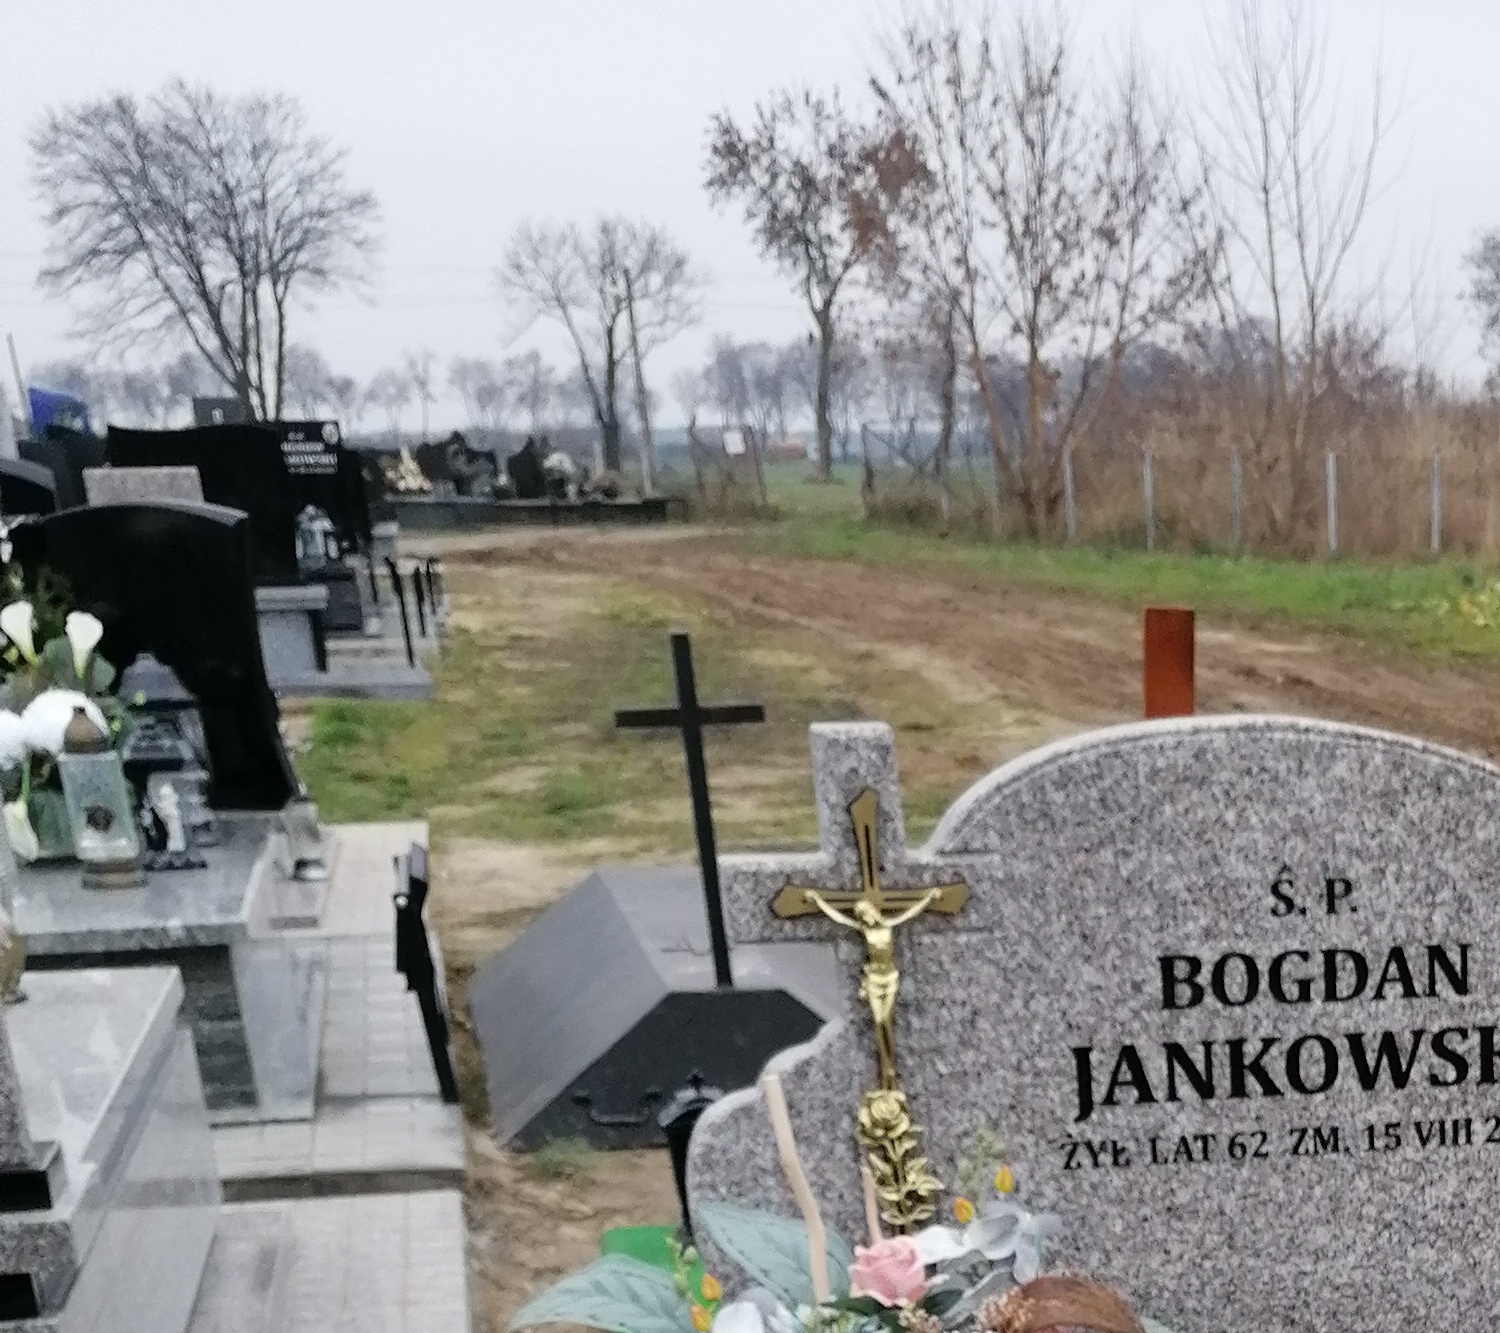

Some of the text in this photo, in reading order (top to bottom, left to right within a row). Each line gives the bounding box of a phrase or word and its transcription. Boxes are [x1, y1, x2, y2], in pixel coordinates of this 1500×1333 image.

[1269, 865, 1358, 918] Ś. P.
[1158, 943, 1472, 1010] BOGDAN
[1060, 1134, 1130, 1171] ŻYŁ
[1149, 1132, 1217, 1166] LAT
[1227, 1130, 1269, 1162] 62
[1289, 1125, 1351, 1158] ZM.
[1366, 1121, 1401, 1152] 15
[1414, 1116, 1473, 1148] VIII
